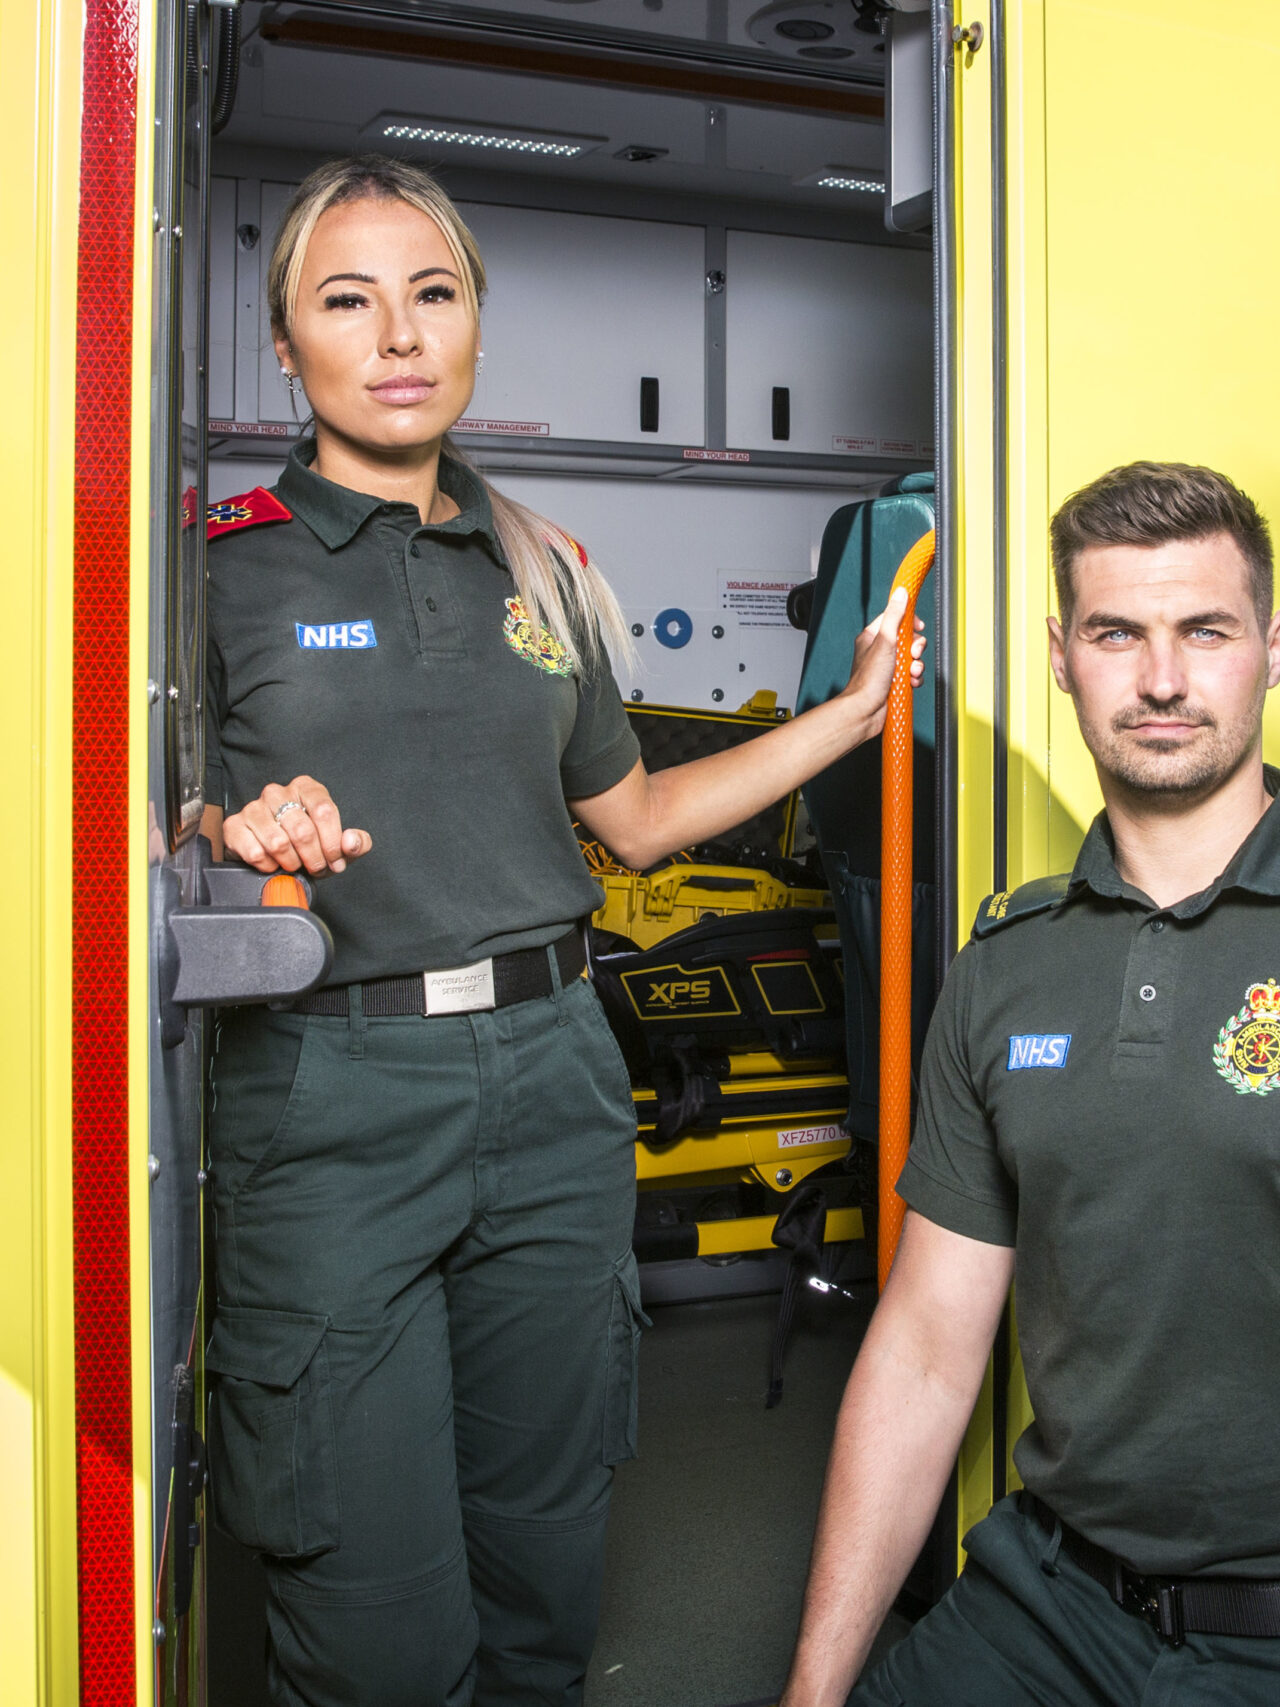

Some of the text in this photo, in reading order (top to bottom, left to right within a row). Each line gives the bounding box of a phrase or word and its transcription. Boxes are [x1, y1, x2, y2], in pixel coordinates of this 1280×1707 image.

[210, 424, 285, 435] MIND YOUR HEAD
[454, 421, 541, 433] AIRWAY MANAGEMENT
[685, 451, 748, 461] MIND YOUR HEAD
[727, 581, 758, 589] VIOLENCE
[761, 582, 788, 590] AGAINST
[303, 624, 369, 647] NHS
[432, 973, 488, 986] AMBULANCE
[442, 984, 480, 995] SERVICE
[648, 980, 711, 1004] XPS
[1011, 1037, 1066, 1066] NHS
[781, 1126, 836, 1146] XFZ5770
